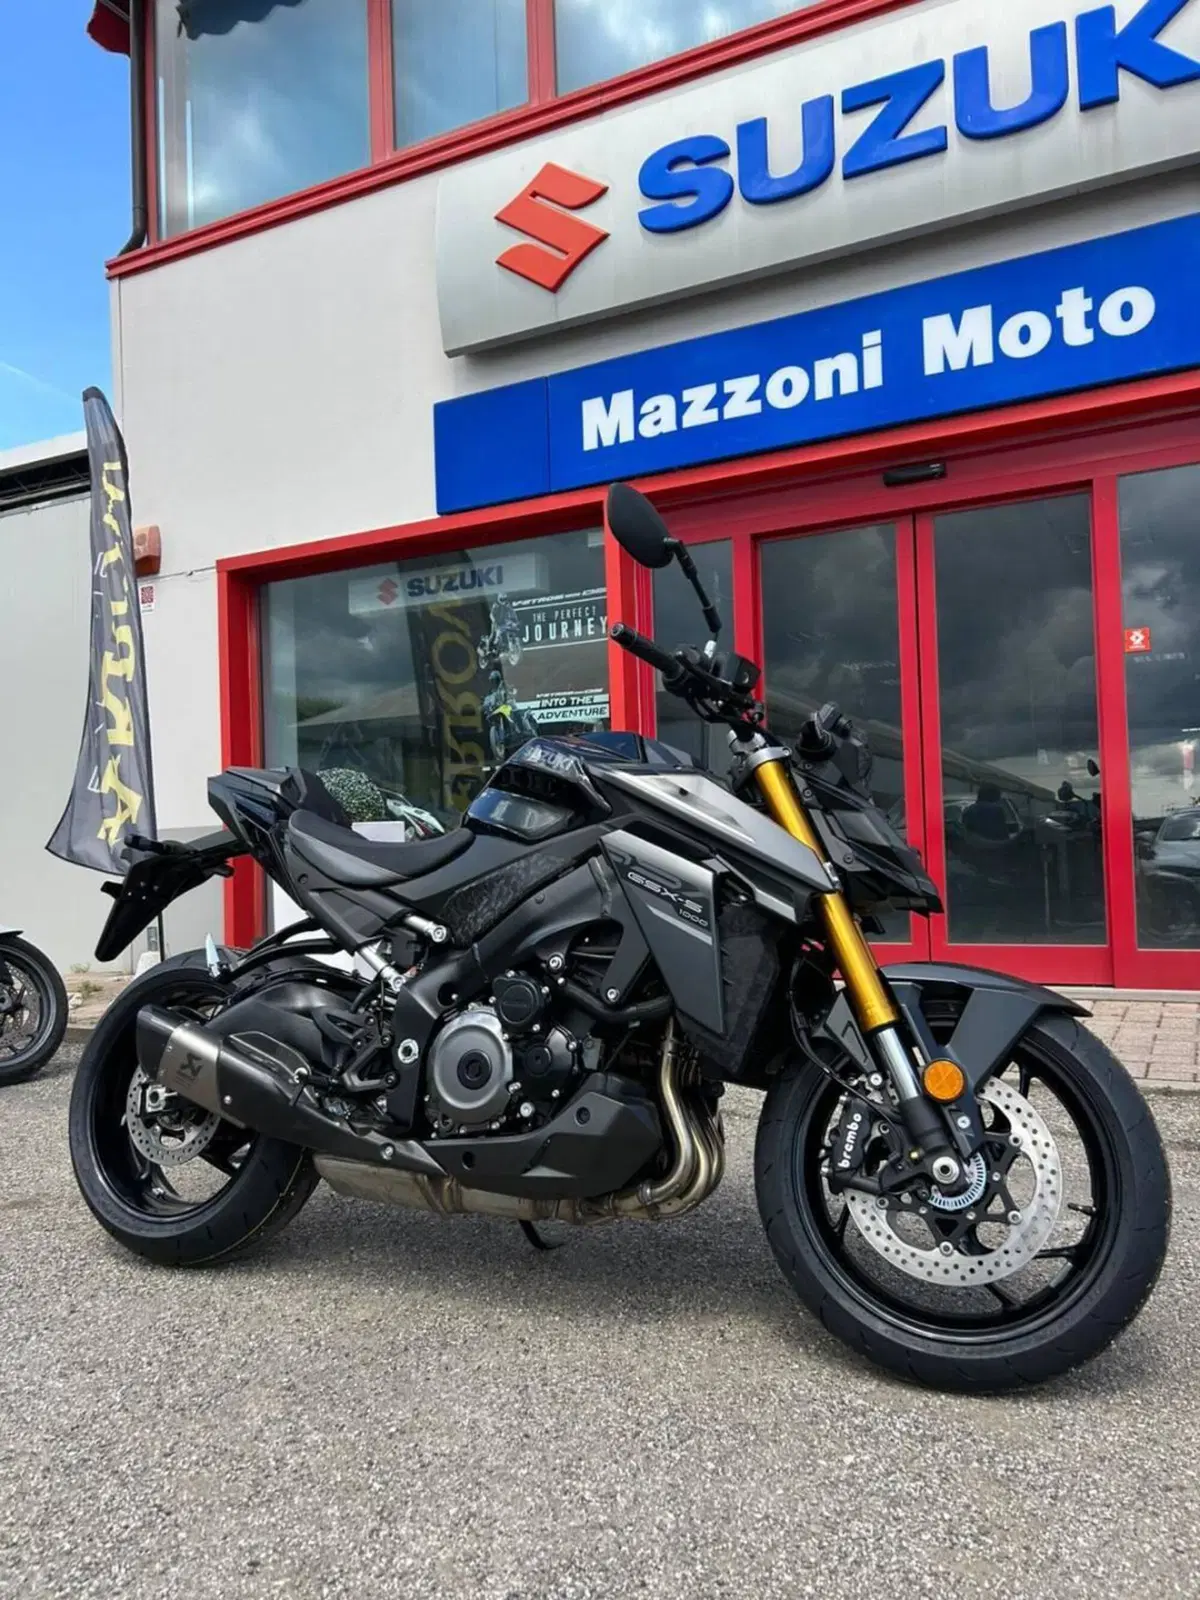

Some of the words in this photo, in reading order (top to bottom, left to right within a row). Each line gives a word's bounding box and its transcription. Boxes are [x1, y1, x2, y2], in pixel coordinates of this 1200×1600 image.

[581, 333, 884, 450] Mazzoni
[922, 286, 1156, 376] Moto
[407, 565, 504, 597] SUZUKI
[533, 612, 546, 622] THE
[555, 606, 596, 620] PERFECT
[523, 616, 607, 642] JOURNEY
[538, 706, 608, 720] ADVENTURE
[541, 698, 567, 708] INTO
[570, 695, 594, 705] THE
[627, 871, 704, 913] GSX-S
[679, 908, 709, 927] 1000
[837, 1112, 862, 1168] brembo
